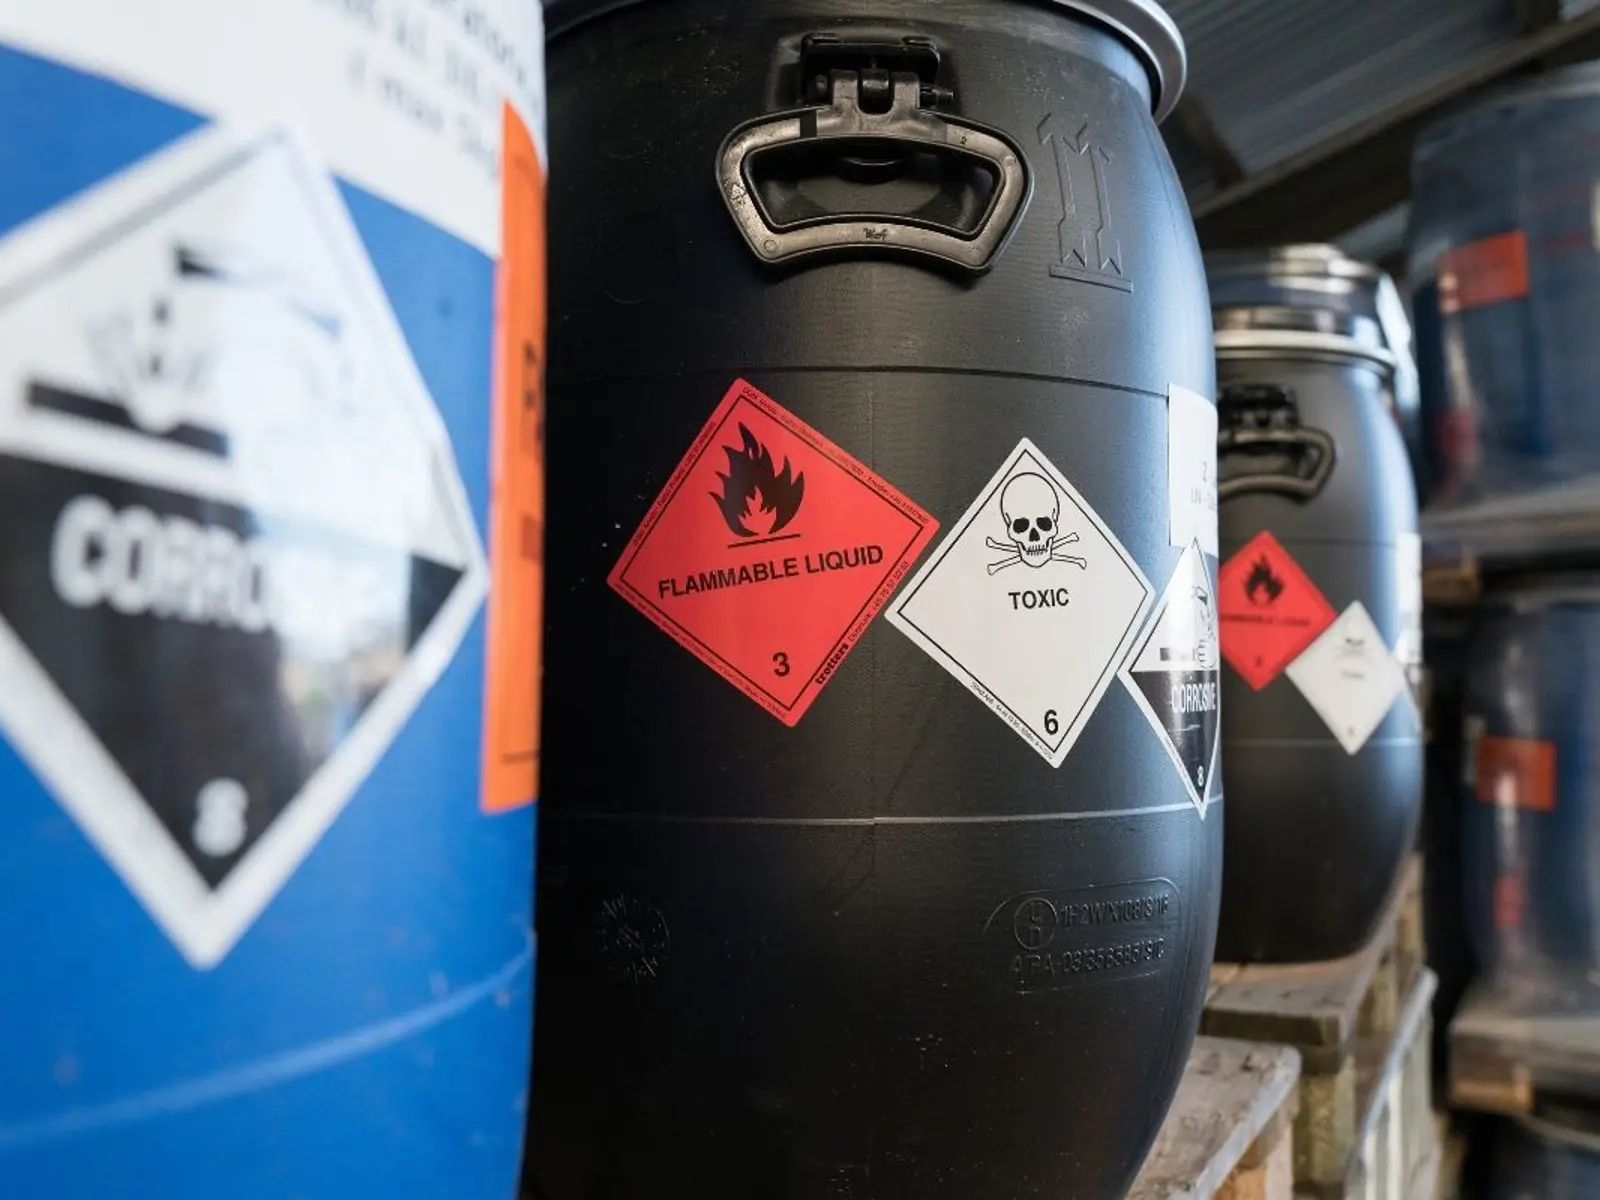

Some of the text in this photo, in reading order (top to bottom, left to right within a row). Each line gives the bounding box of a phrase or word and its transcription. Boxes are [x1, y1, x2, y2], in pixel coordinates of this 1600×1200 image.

[658, 557, 799, 599] FLAMMABLE
[804, 545, 884, 574] LIQUID
[1008, 587, 1069, 610] TOXIC
[772, 651, 791, 678] 3
[815, 642, 850, 685] trotters
[1044, 708, 1059, 735] 6
[1197, 765, 1204, 787] 8
